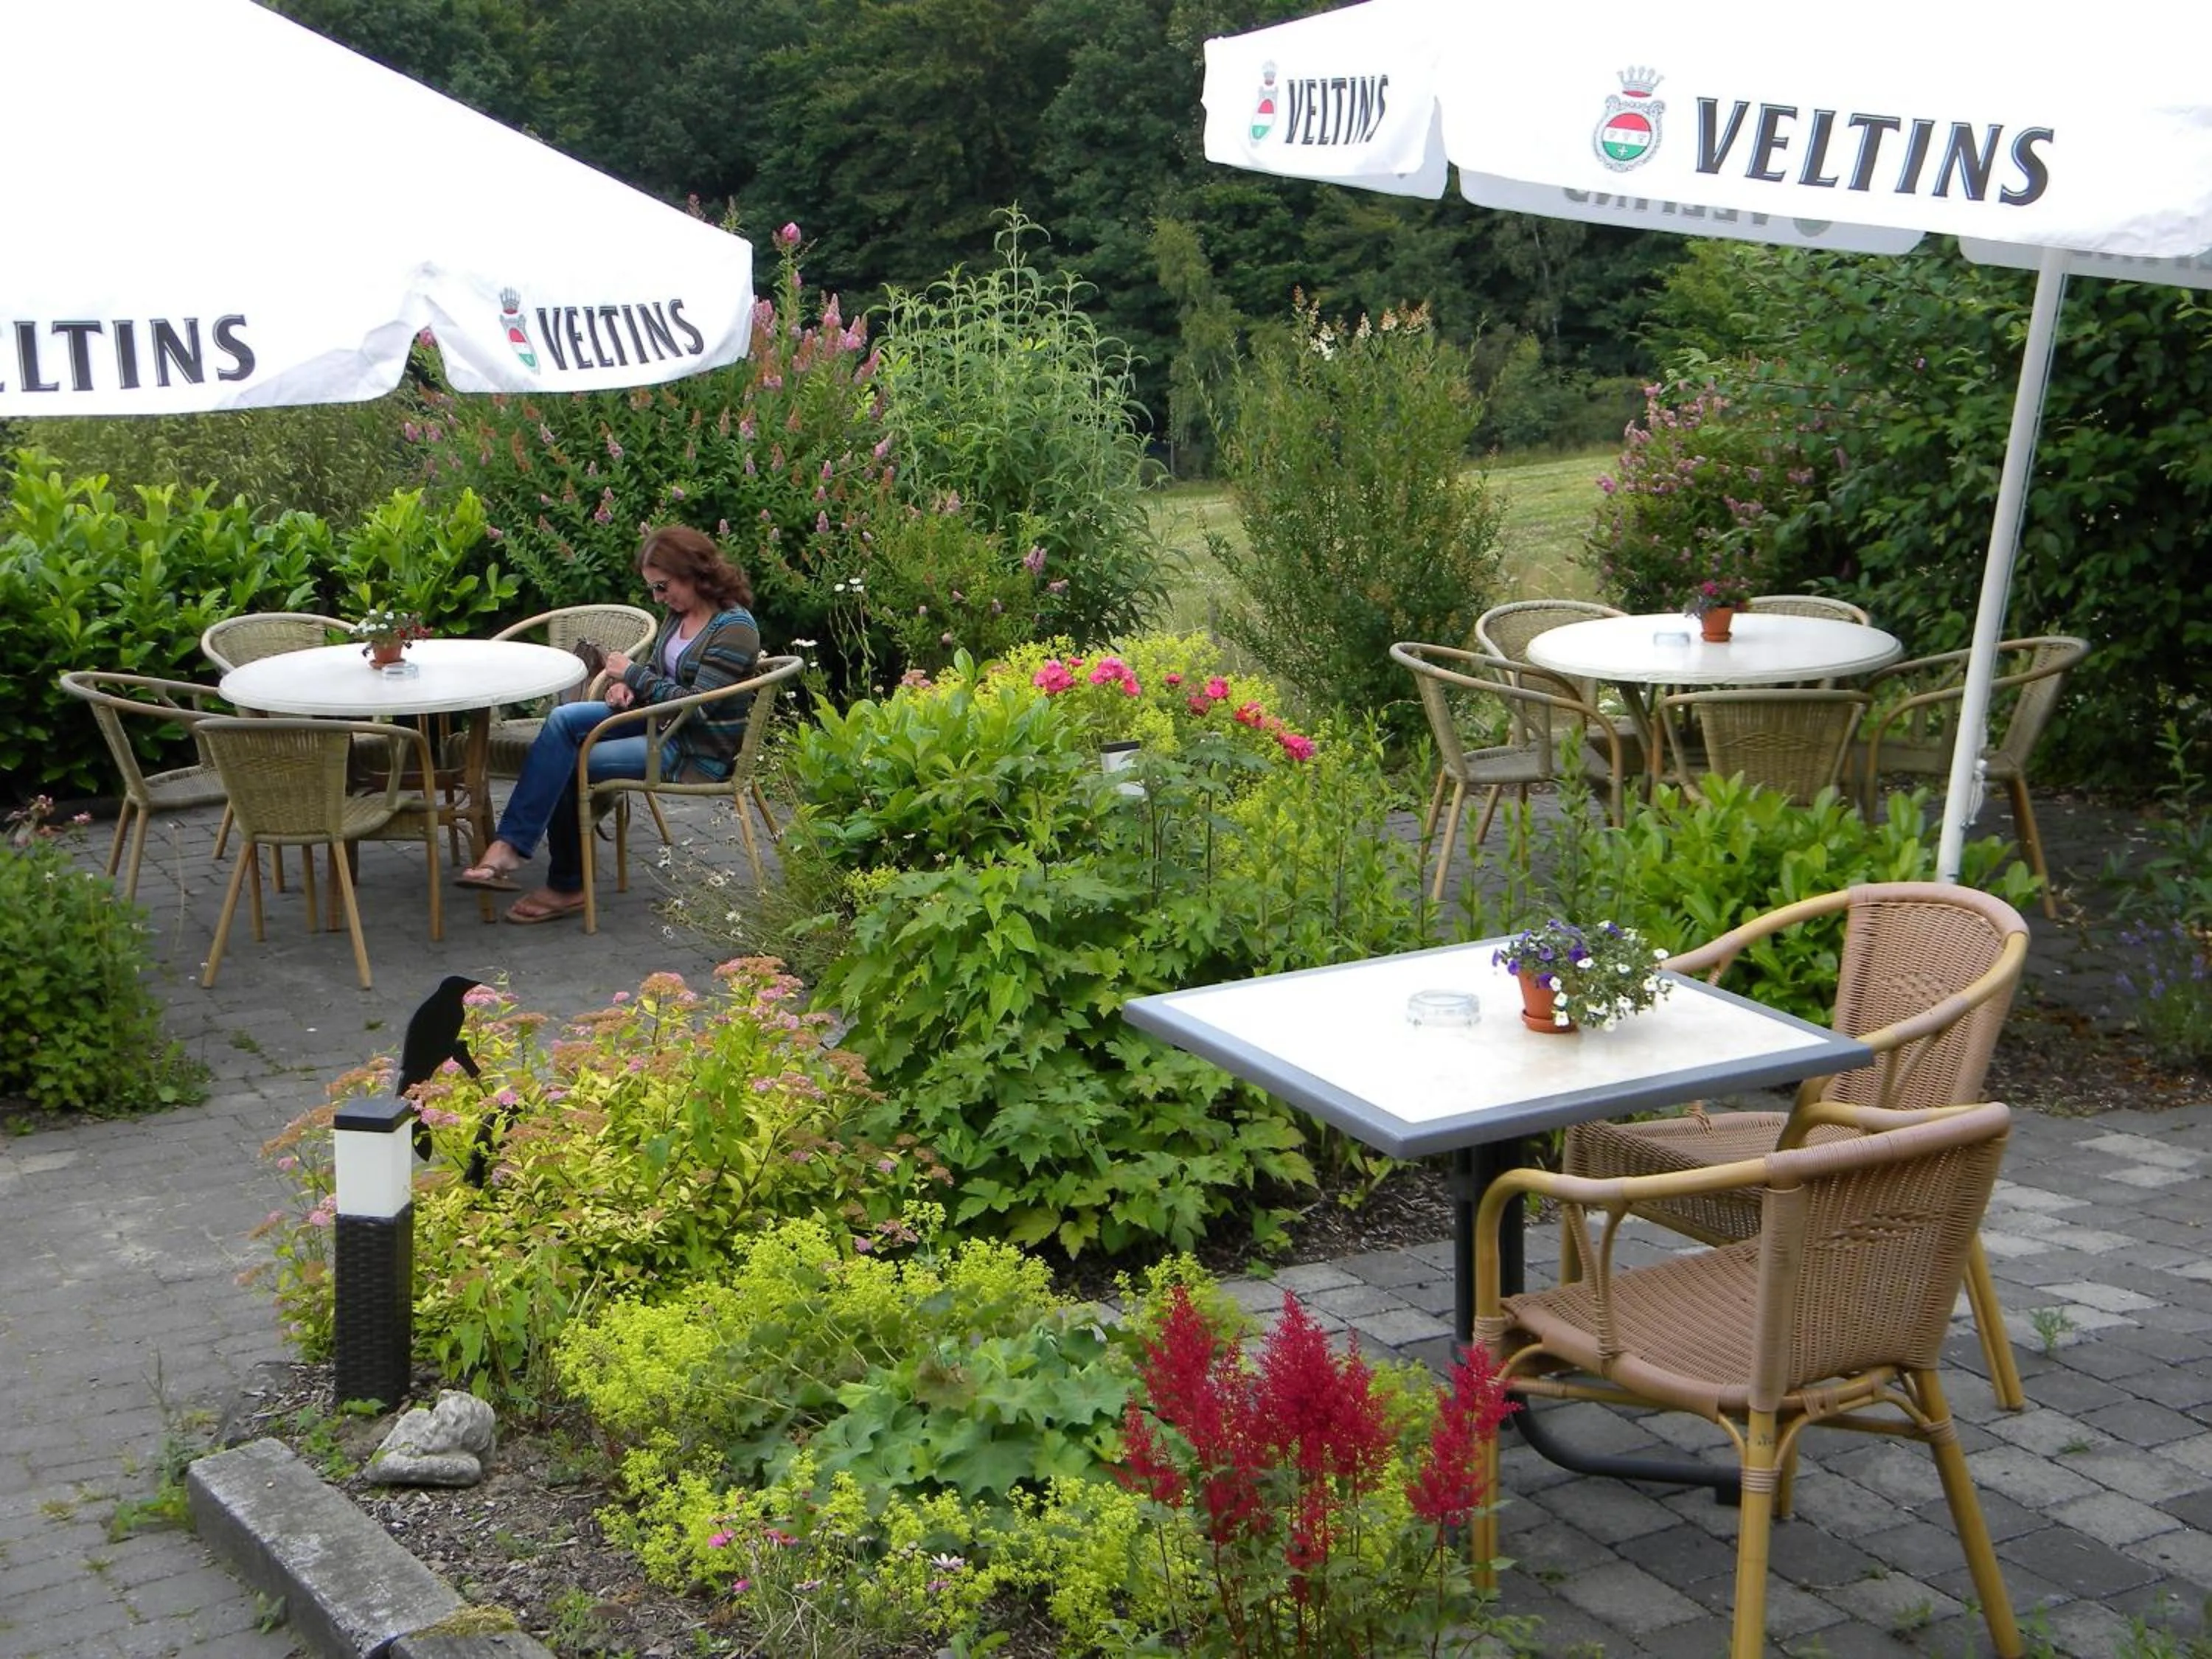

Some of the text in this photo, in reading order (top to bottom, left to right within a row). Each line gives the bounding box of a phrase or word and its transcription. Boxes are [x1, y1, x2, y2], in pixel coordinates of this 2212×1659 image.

[1284, 74, 1389, 145] VELTINS
[1695, 96, 2055, 207] VELTINS
[0, 314, 256, 392] LTINS
[536, 299, 704, 370] VELTINS
